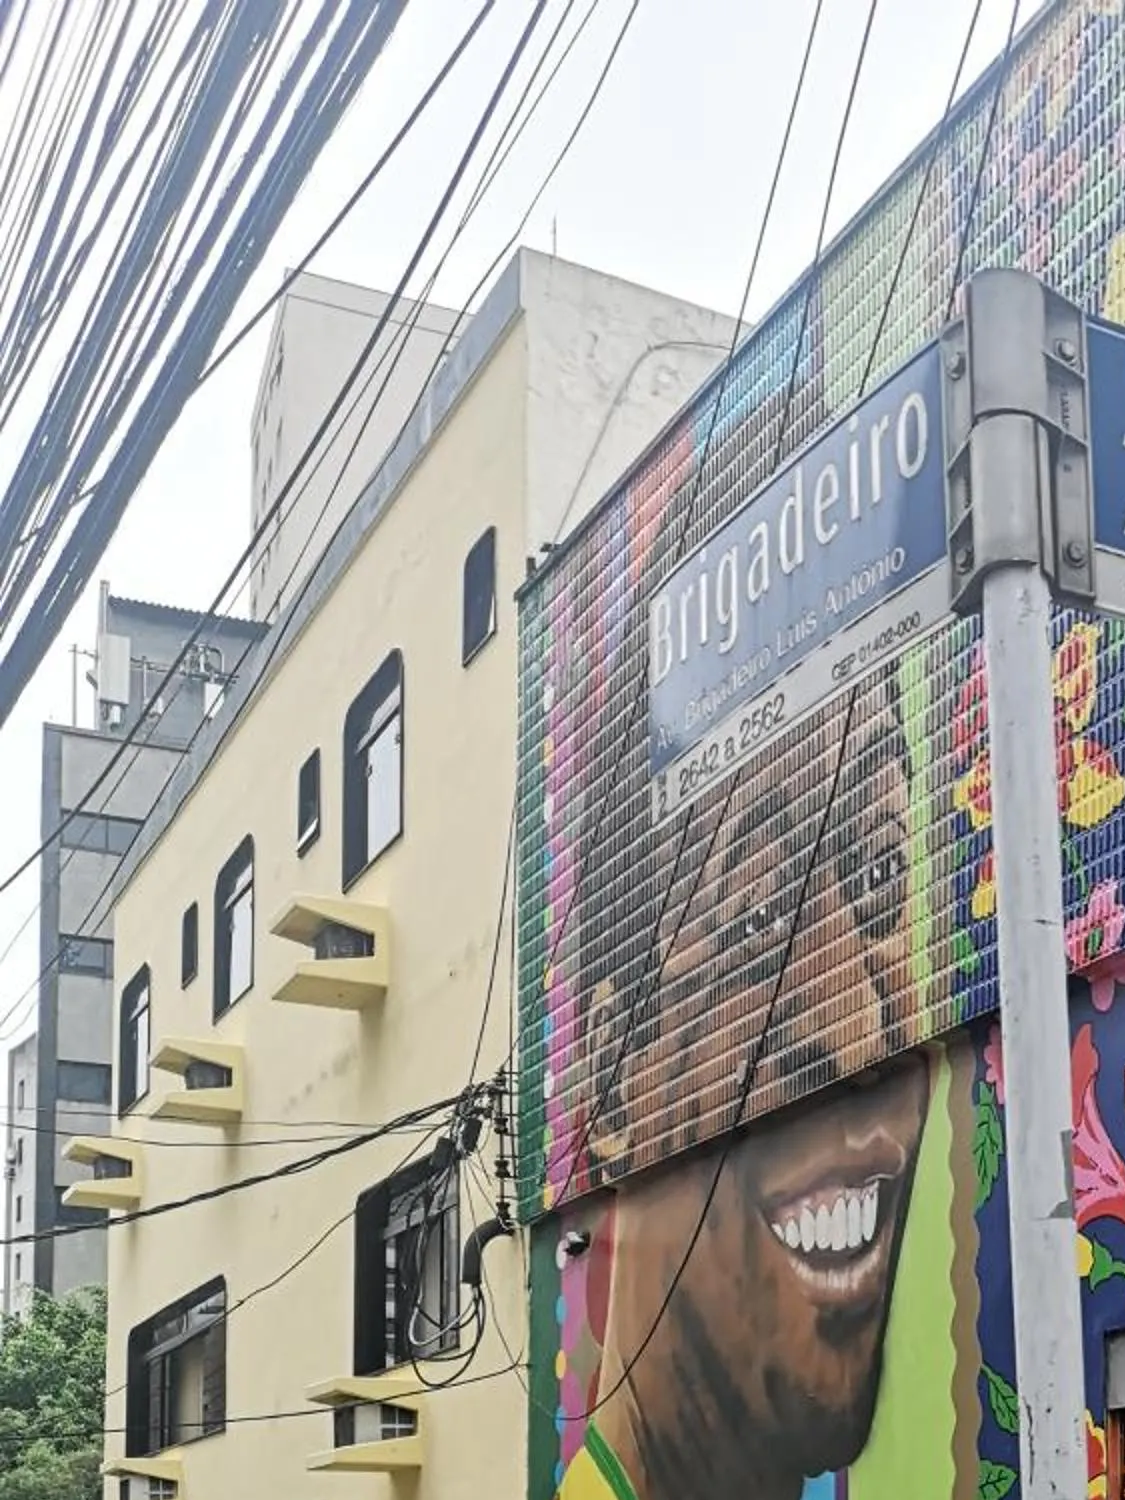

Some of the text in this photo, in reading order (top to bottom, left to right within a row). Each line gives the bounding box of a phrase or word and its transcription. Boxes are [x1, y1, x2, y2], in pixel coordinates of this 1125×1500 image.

[650, 392, 929, 687] Brigadeiro
[832, 653, 857, 681] CEP
[679, 693, 786, 795] 2642 a 2562
